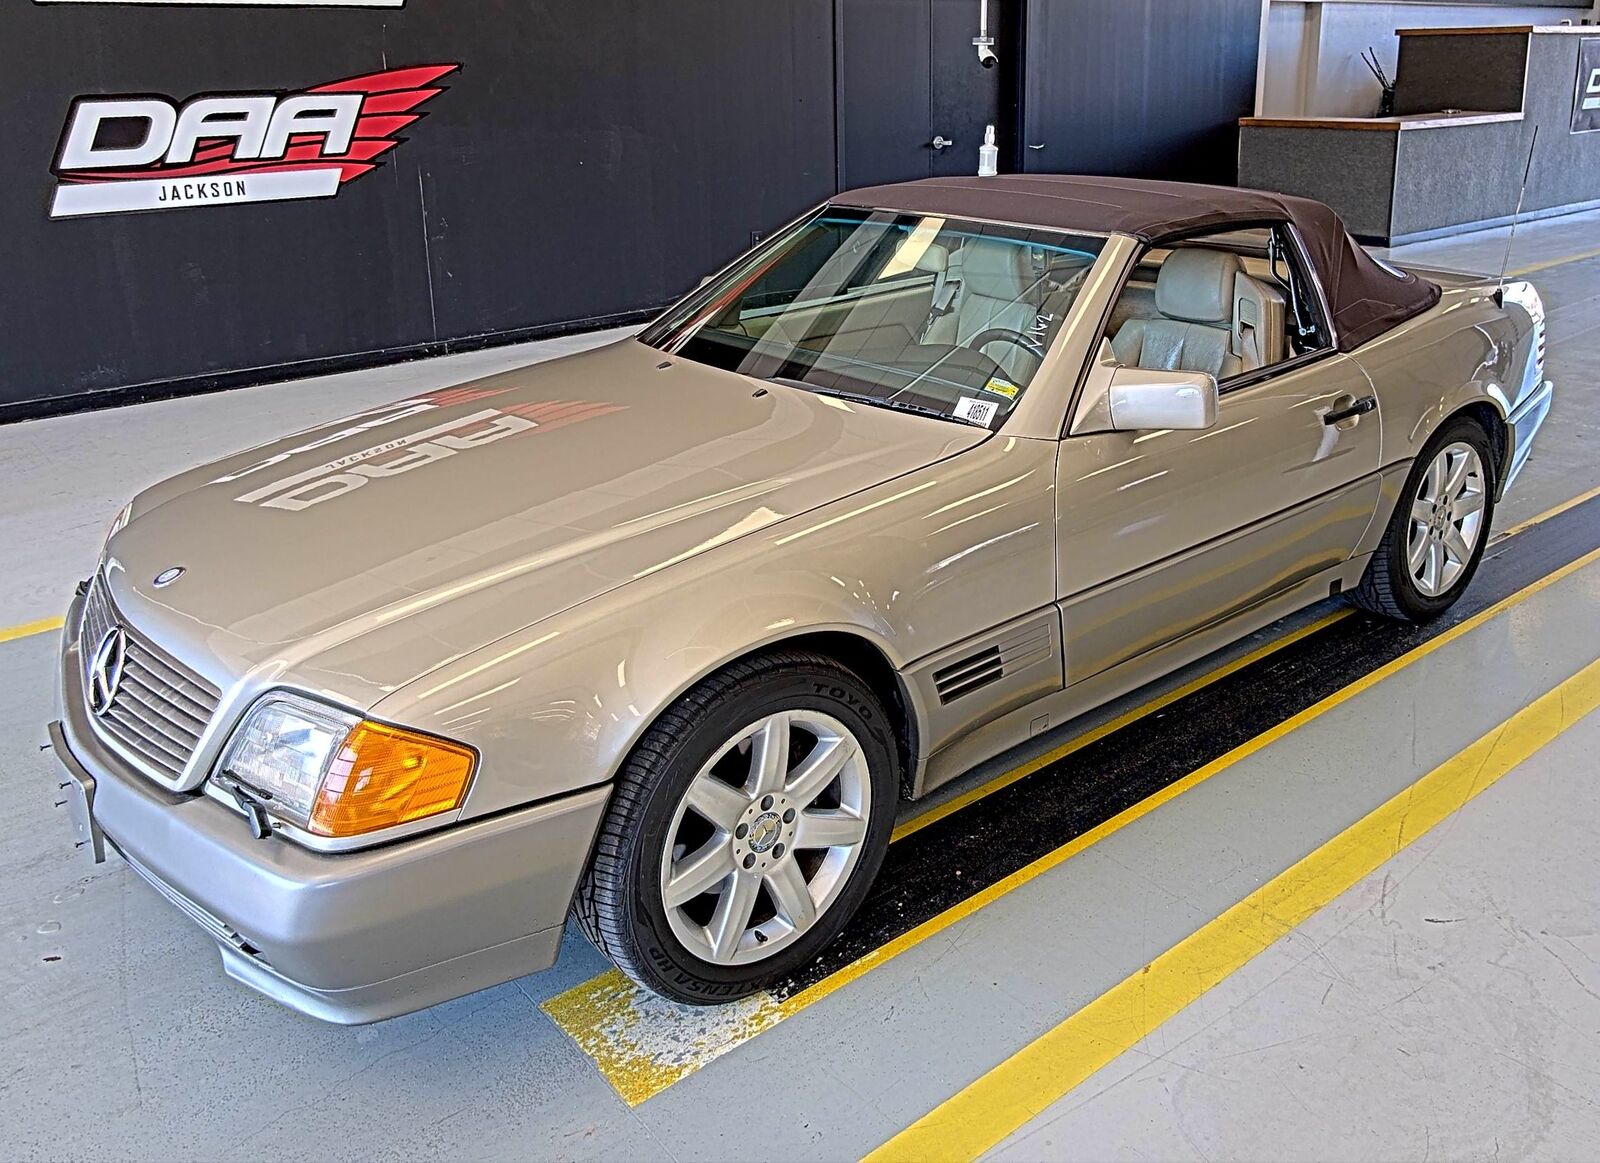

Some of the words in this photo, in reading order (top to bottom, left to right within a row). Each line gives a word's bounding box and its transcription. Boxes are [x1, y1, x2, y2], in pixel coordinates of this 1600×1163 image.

[59, 94, 364, 169] DAA
[158, 181, 247, 202] JACKSON
[813, 683, 872, 720] TOYO
[673, 968, 775, 996] XTENSA
